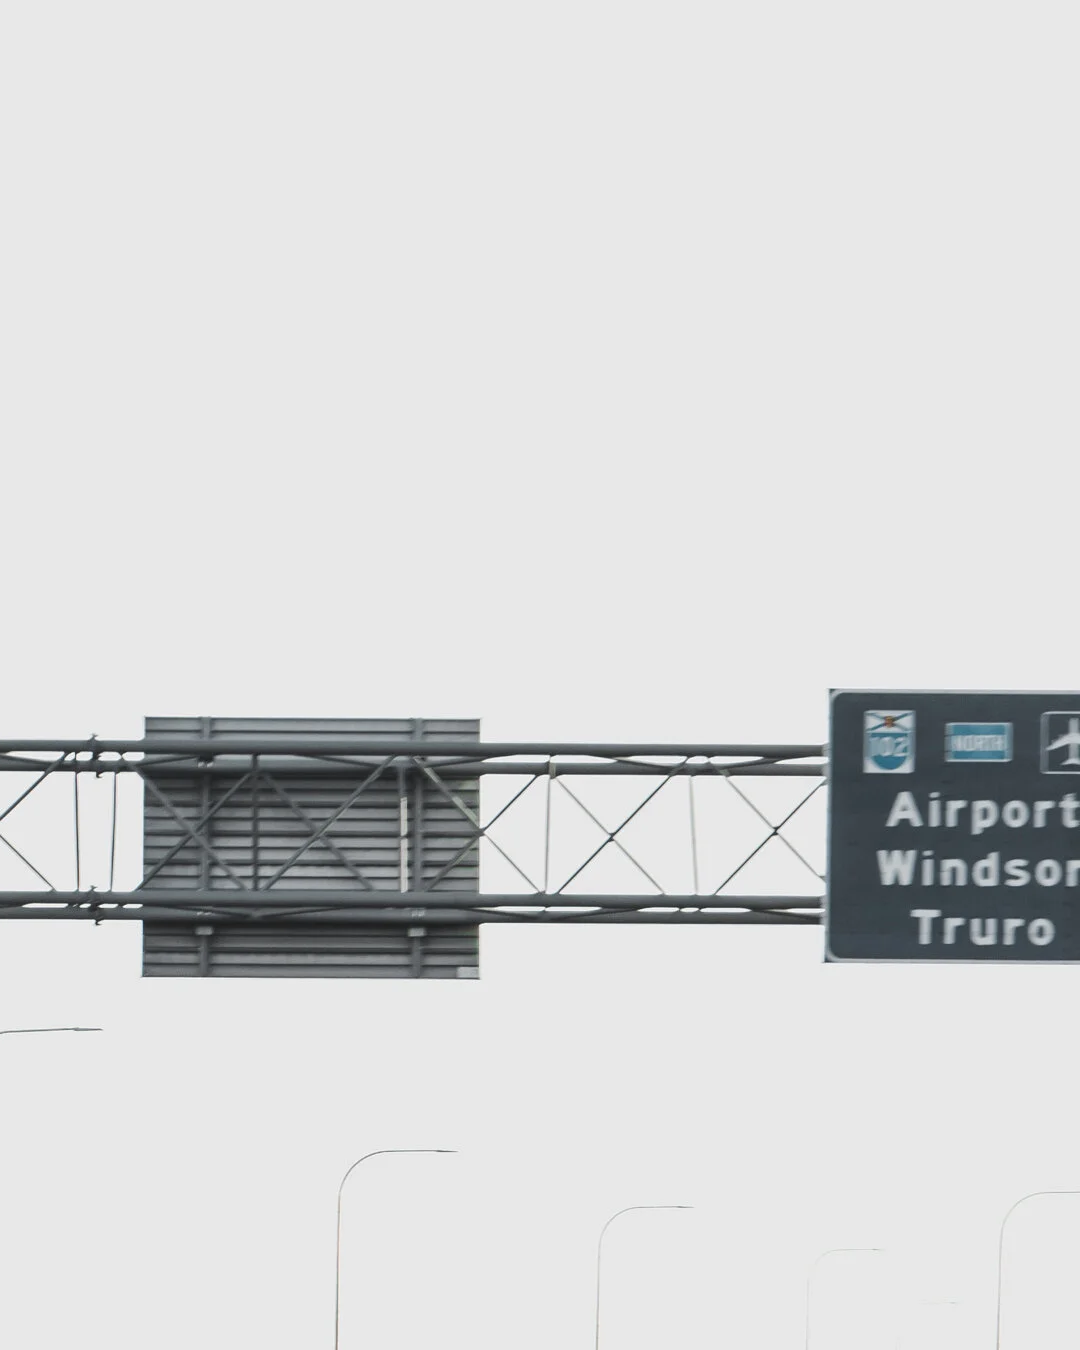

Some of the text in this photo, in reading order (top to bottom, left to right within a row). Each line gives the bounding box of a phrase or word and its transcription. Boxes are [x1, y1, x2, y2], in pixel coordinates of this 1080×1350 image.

[885, 791, 1080, 835] Airport
[876, 850, 1080, 887] Windsor
[910, 909, 1056, 946] Truro
